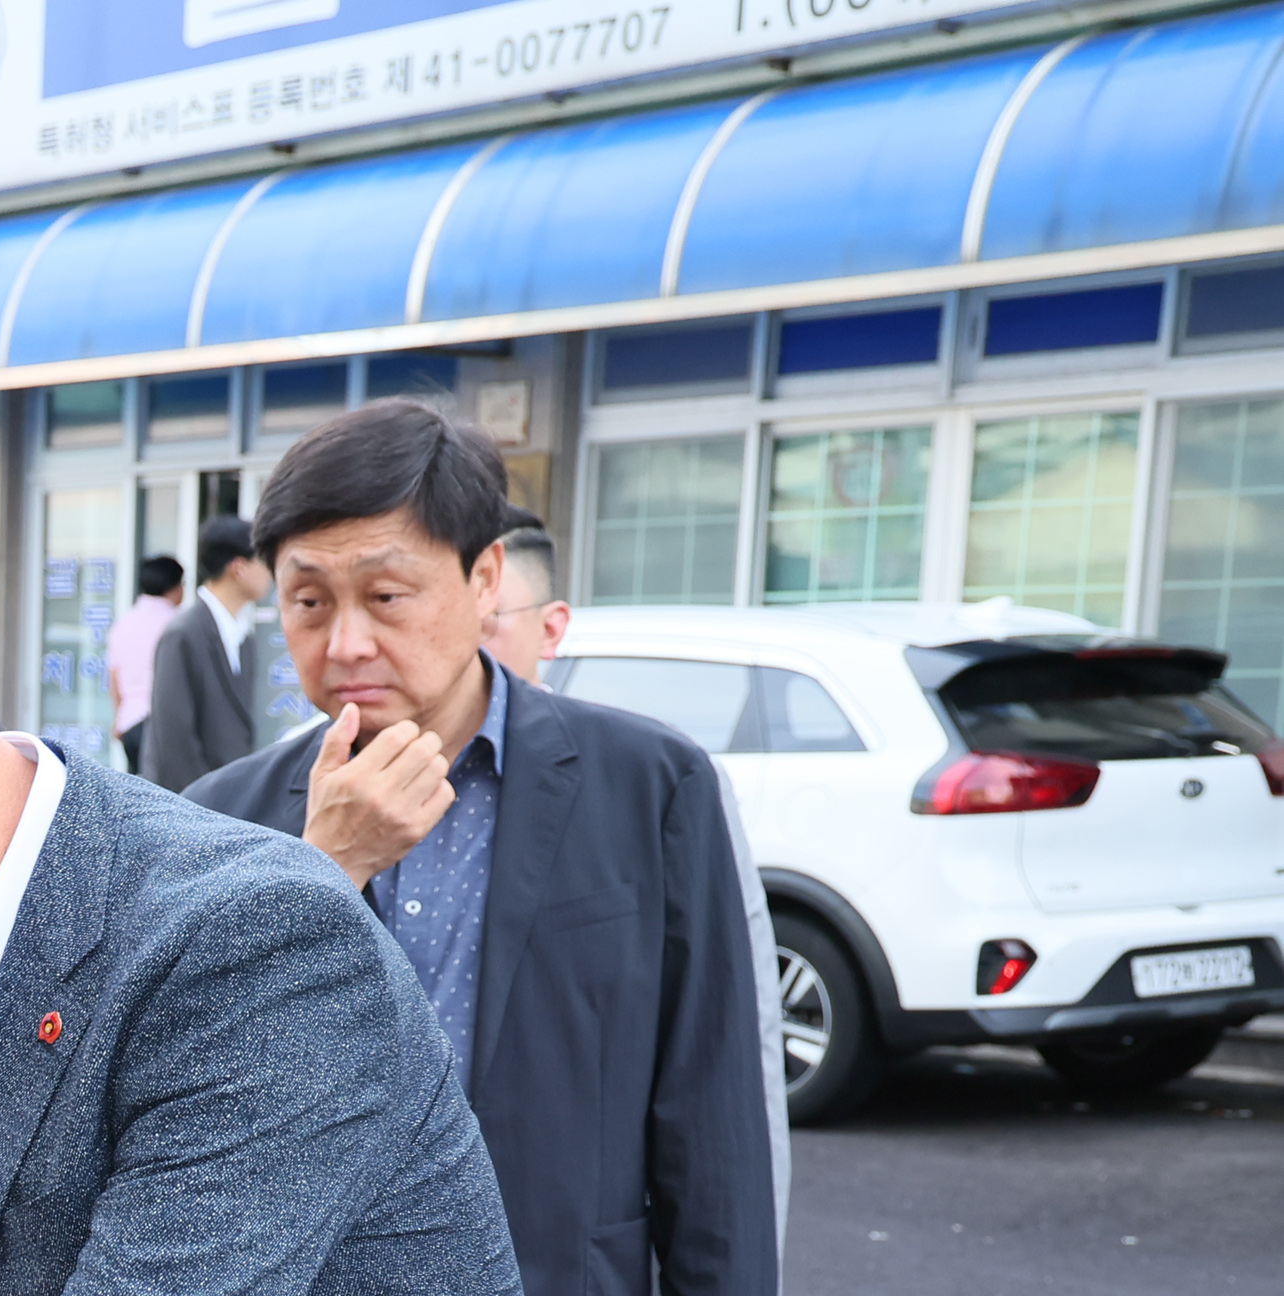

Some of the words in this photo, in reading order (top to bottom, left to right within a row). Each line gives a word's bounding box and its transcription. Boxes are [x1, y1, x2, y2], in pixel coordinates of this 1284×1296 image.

[38, 112, 116, 159] 특허청
[123, 89, 237, 143] 서비스표
[247, 64, 369, 125] 등록번호
